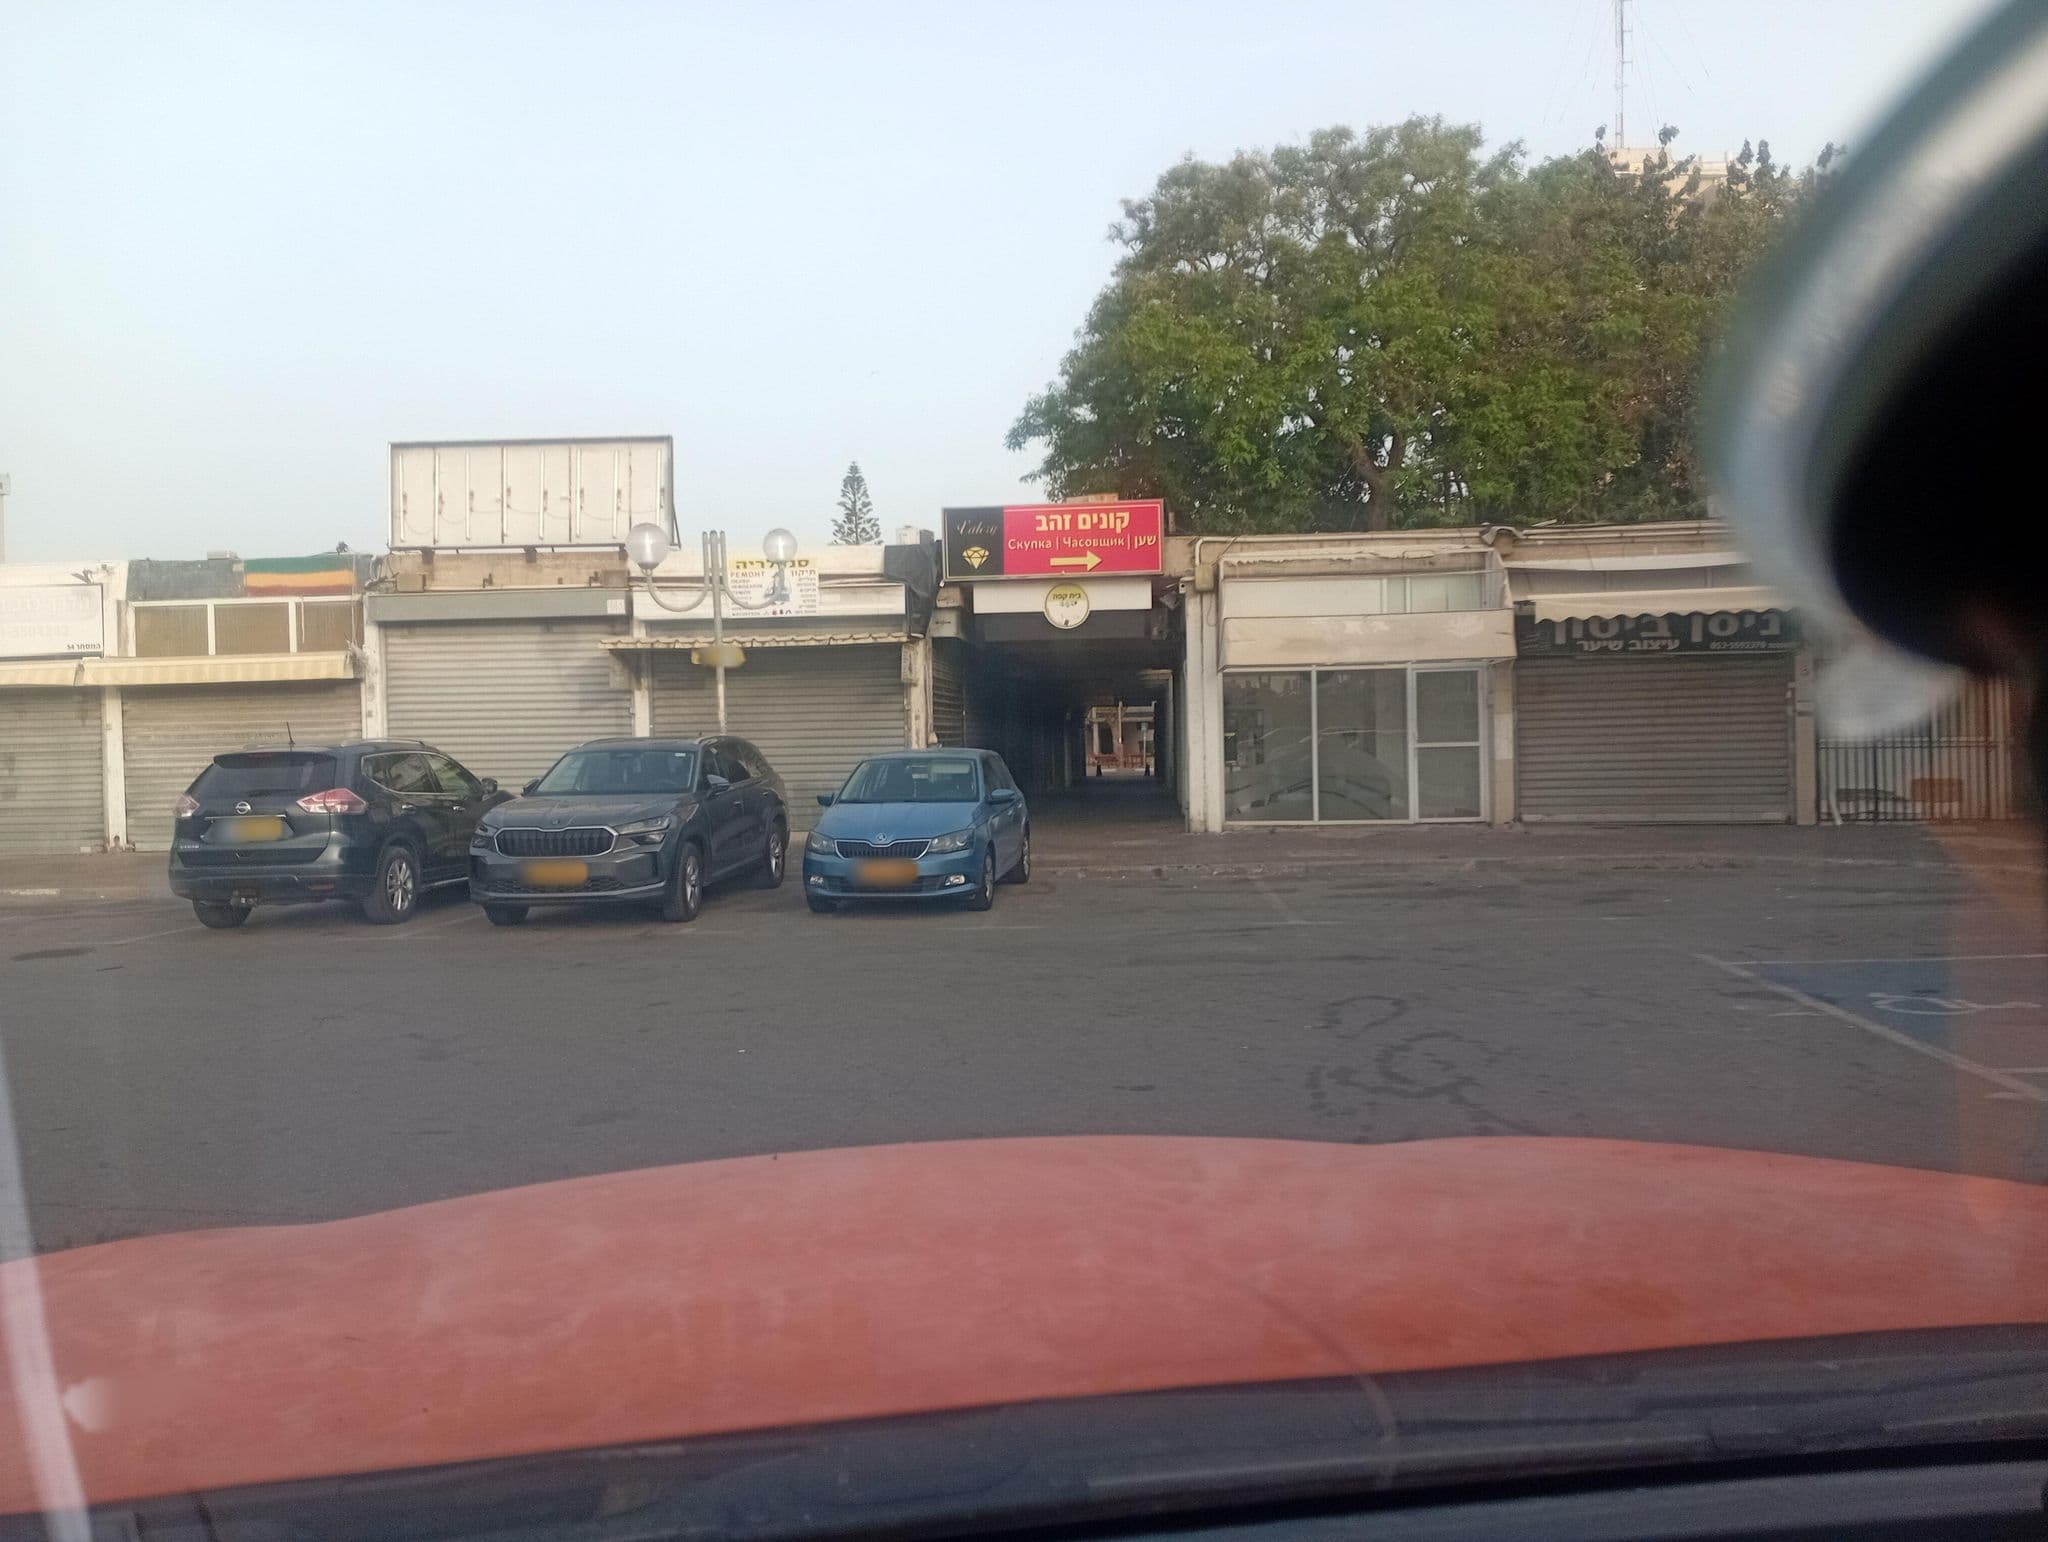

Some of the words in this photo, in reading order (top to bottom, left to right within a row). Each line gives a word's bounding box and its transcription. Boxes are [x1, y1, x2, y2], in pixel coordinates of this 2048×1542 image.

[1035, 513, 1072, 532] זהב
[1078, 511, 1130, 534] קונים
[1007, 538, 1052, 551] Скупка
[1062, 535, 1125, 549] Часовщик
[1134, 535, 1157, 550] שען
[730, 570, 766, 578] РЕМОНТ
[791, 569, 816, 577] תיקון
[1690, 612, 1781, 643] ניסן
[1576, 640, 1624, 652] שיער
[1628, 639, 1680, 651] עיצוב
